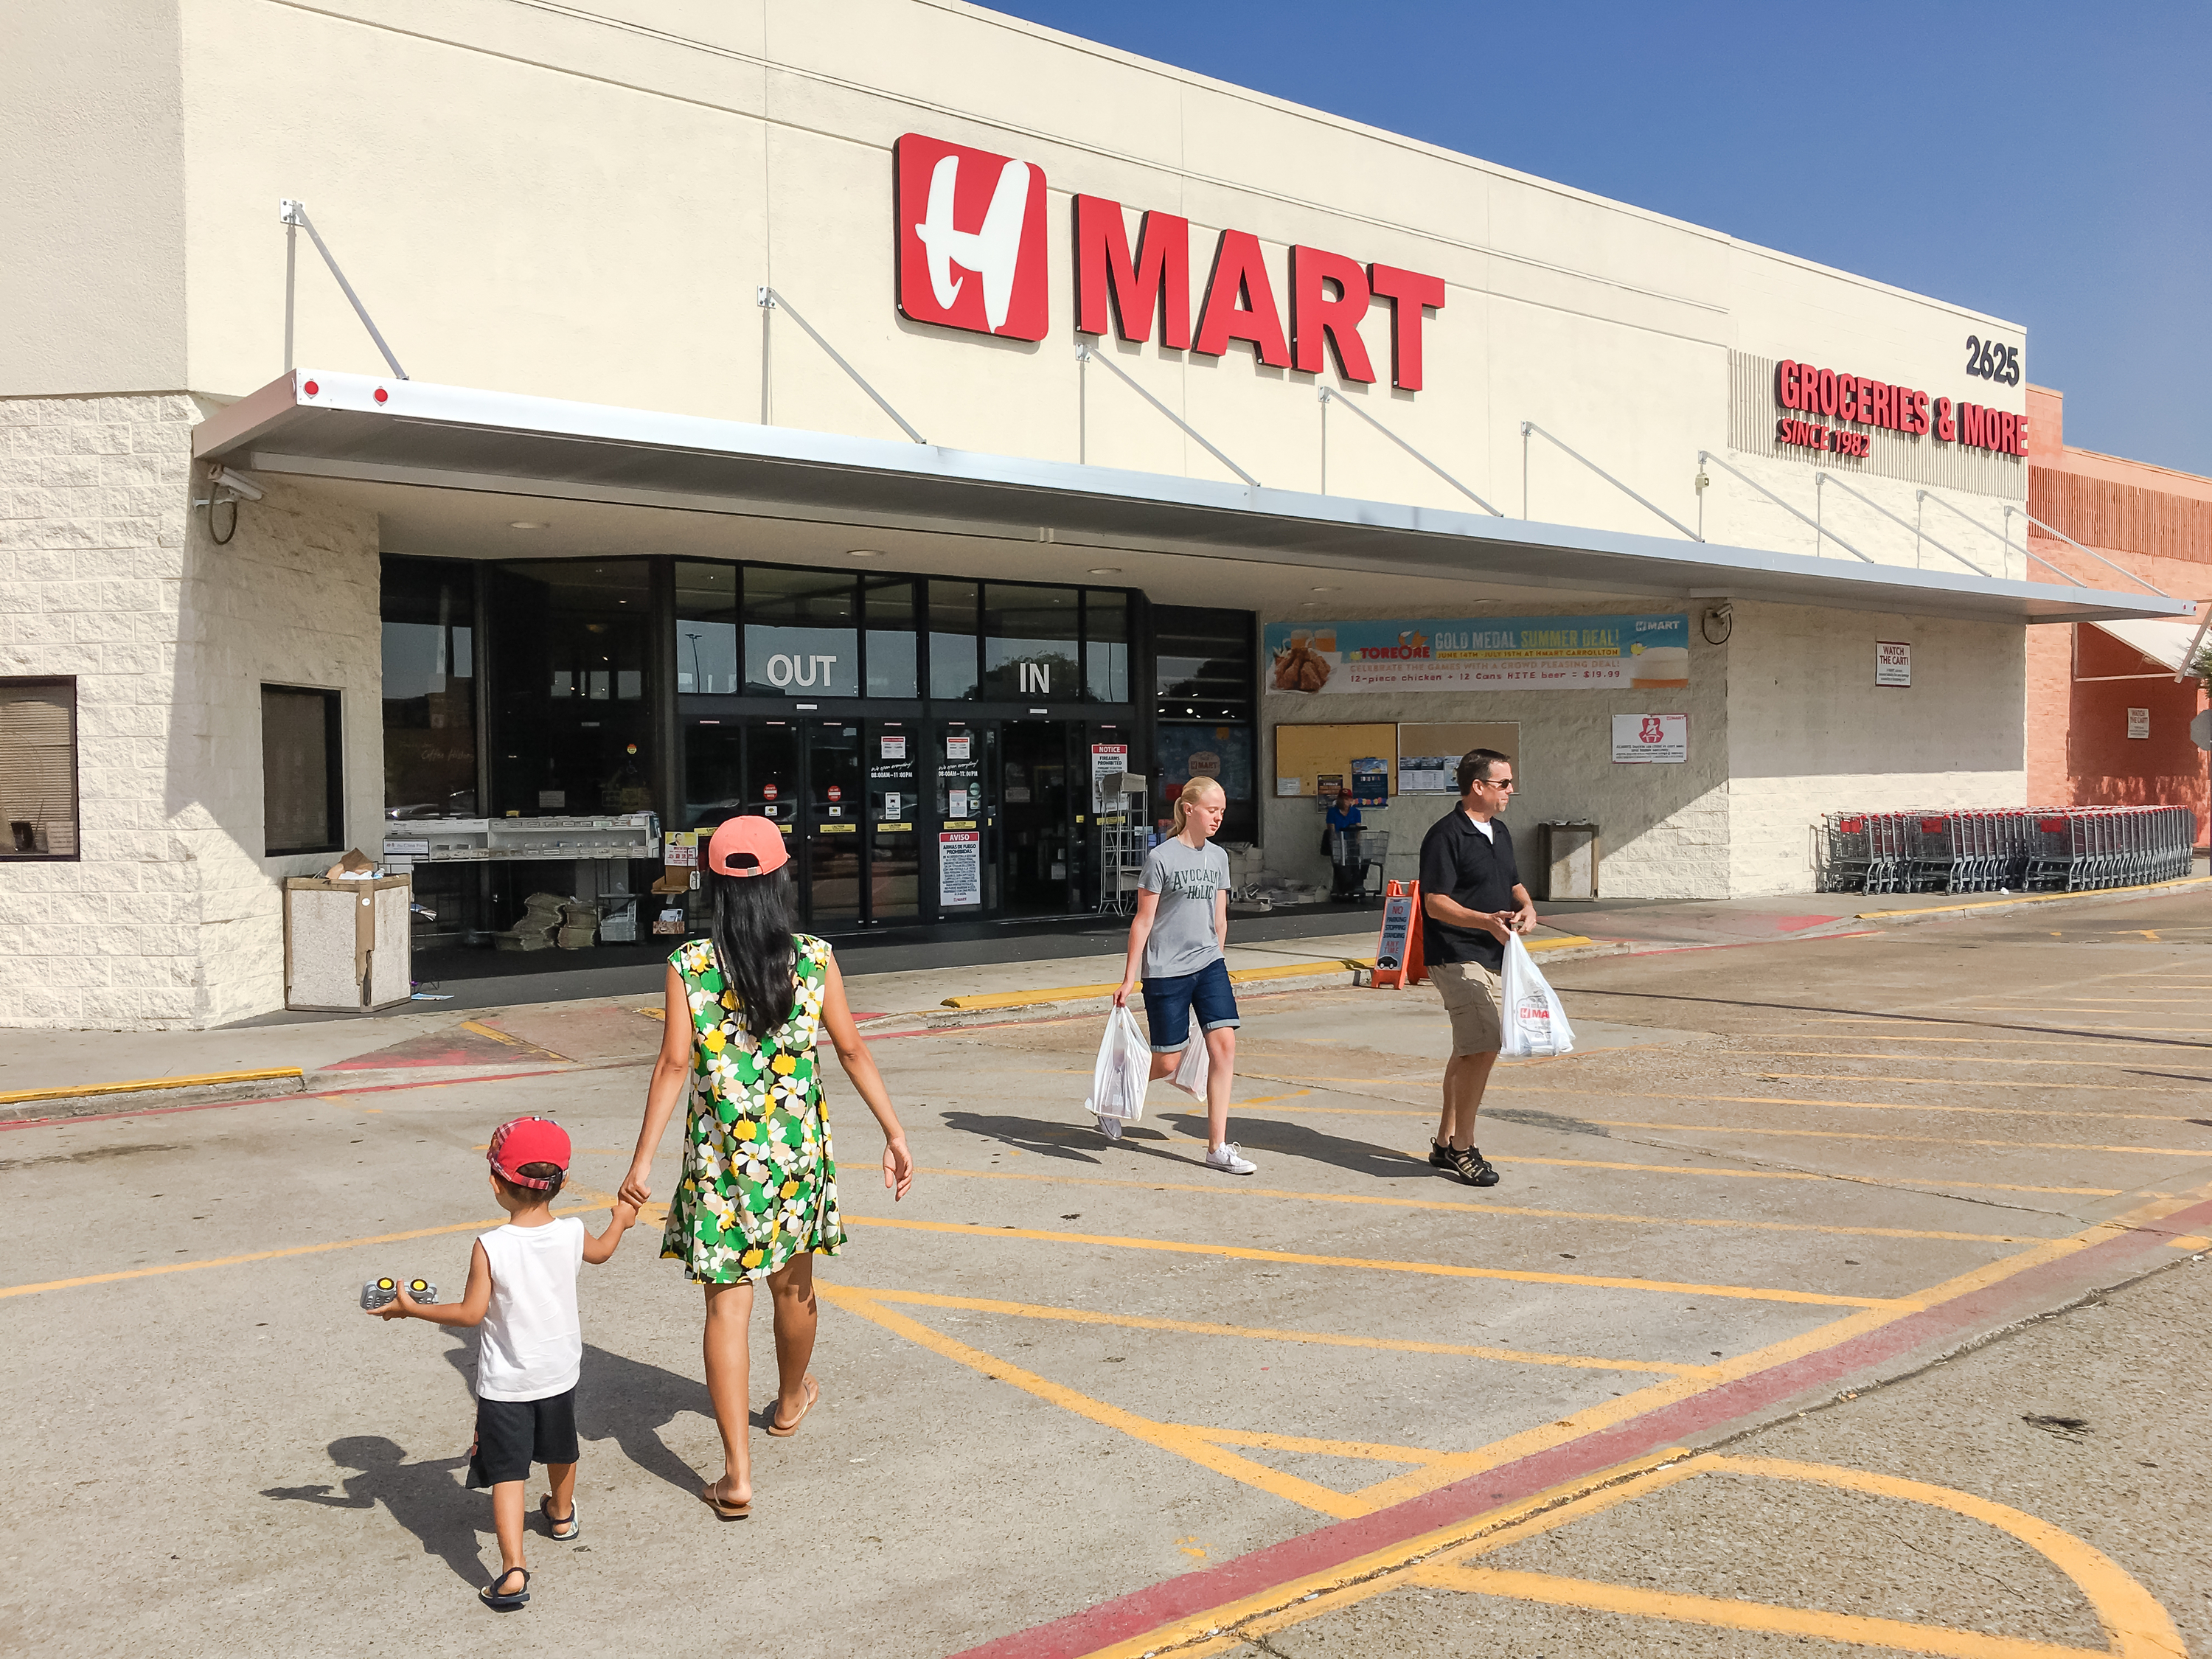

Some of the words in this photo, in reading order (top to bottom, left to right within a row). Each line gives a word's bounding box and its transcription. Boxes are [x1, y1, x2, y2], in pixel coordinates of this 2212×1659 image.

[1072, 193, 1446, 392] MART
[1966, 335, 2020, 387] 2625
[1775, 358, 1930, 436] GROCERIES
[1933, 396, 1956, 442] &
[1958, 401, 2028, 457] MORE
[1777, 417, 1829, 451] SINCE
[1830, 429, 1871, 458] 1982
[1647, 621, 1680, 630] MART
[1435, 631, 1469, 650] GOLD
[1472, 630, 1517, 650] MEDAL
[1520, 629, 1579, 648] SUMMER
[1582, 628, 1619, 647] DEAL!
[1879, 655, 1891, 664] THE
[1892, 655, 1909, 665] CART!
[1882, 646, 1905, 655] WATCH
[767, 653, 838, 687] OUT
[1350, 664, 1402, 672] CELEBRATE
[1406, 664, 1424, 672] THE
[1427, 663, 1461, 671] GAMES
[1464, 662, 1489, 670] WITH
[1500, 661, 1537, 669] CROWD
[1540, 661, 1588, 669] PLEASING
[1591, 660, 1620, 668] DEAL!
[1350, 675, 1397, 684] 12-piece
[1401, 672, 1442, 682] chicken
[1507, 672, 1536, 680] HITE
[1541, 671, 1566, 679] beer
[1583, 670, 1621, 678] $19.99
[1020, 662, 1051, 694] IN
[1391, 905, 1404, 914] NO
